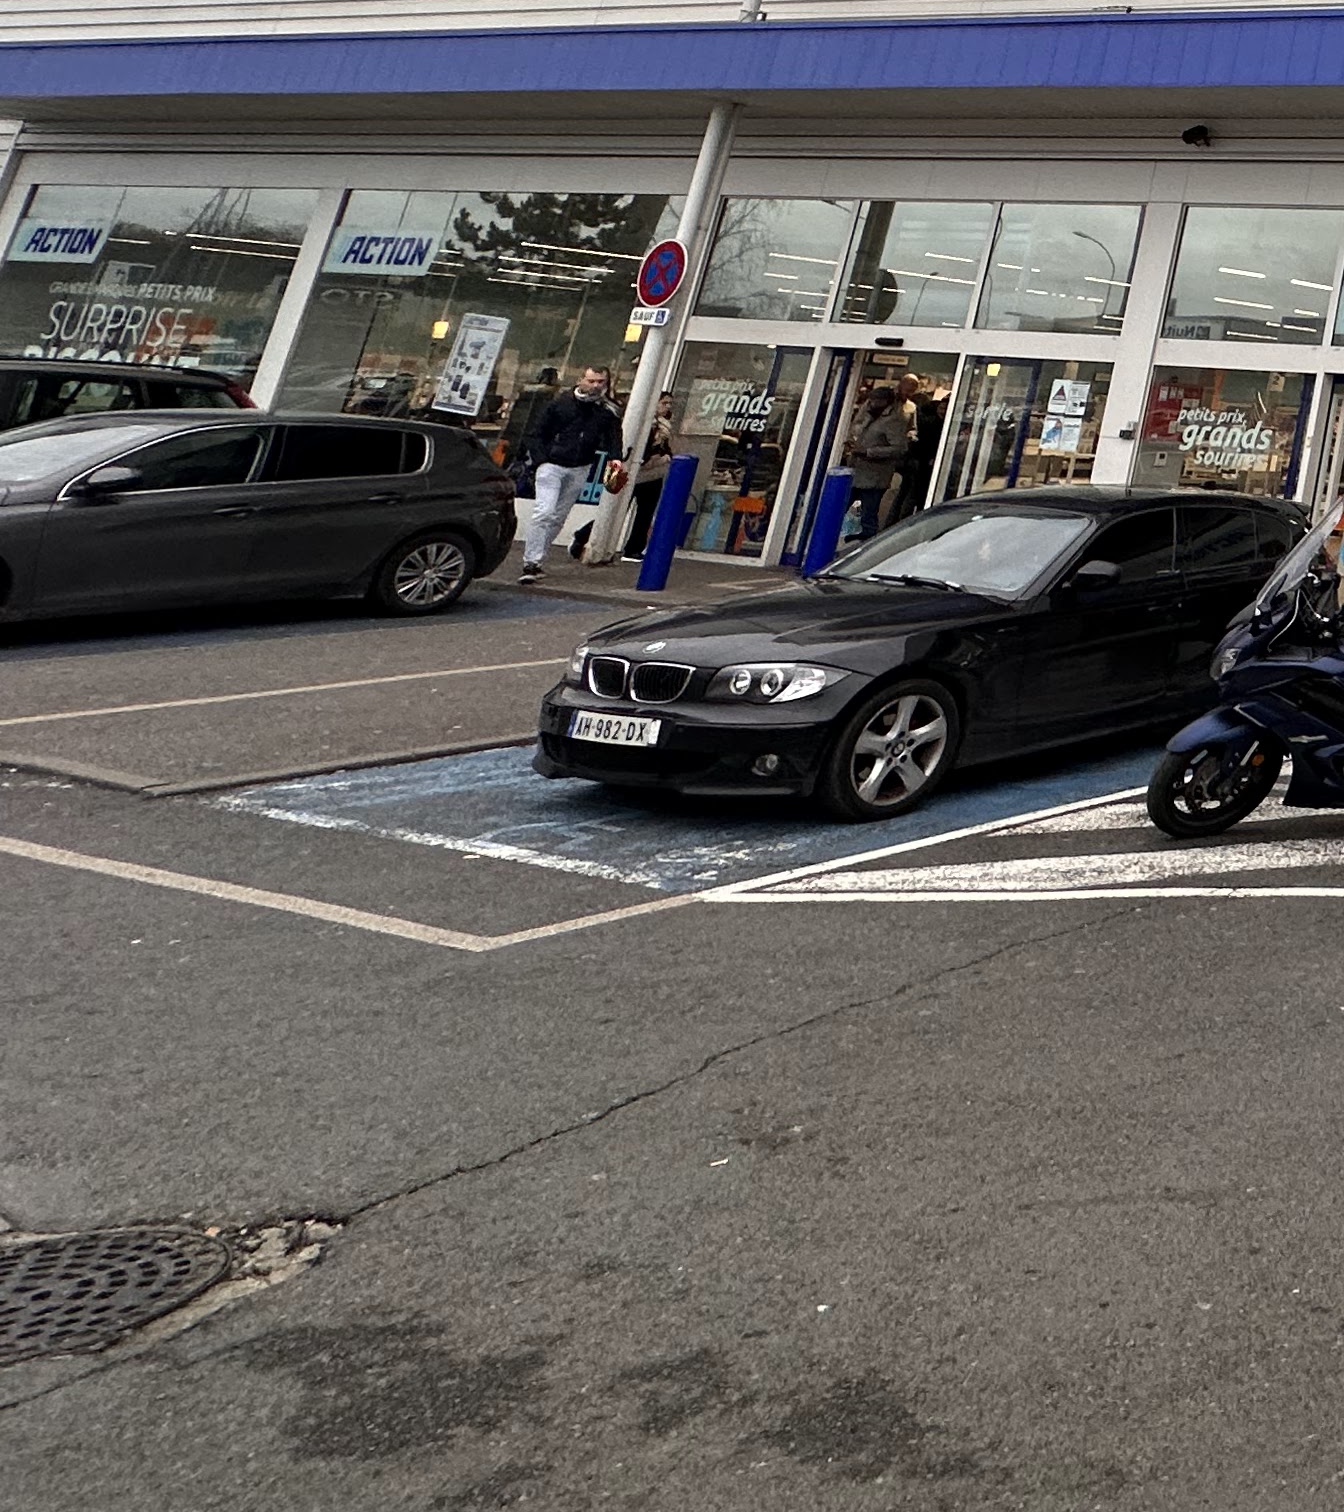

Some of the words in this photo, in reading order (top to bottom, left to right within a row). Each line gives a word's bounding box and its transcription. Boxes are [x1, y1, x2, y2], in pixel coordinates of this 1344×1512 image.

[24, 227, 103, 254] ACTION
[341, 235, 433, 266] ACTION
[40, 301, 193, 348] SURPRISE
[632, 311, 655, 321] SAUF
[700, 389, 776, 416] grands
[1178, 408, 1216, 424] petits
[1178, 420, 1273, 452] grands
[575, 716, 648, 742] AH-982-DX
